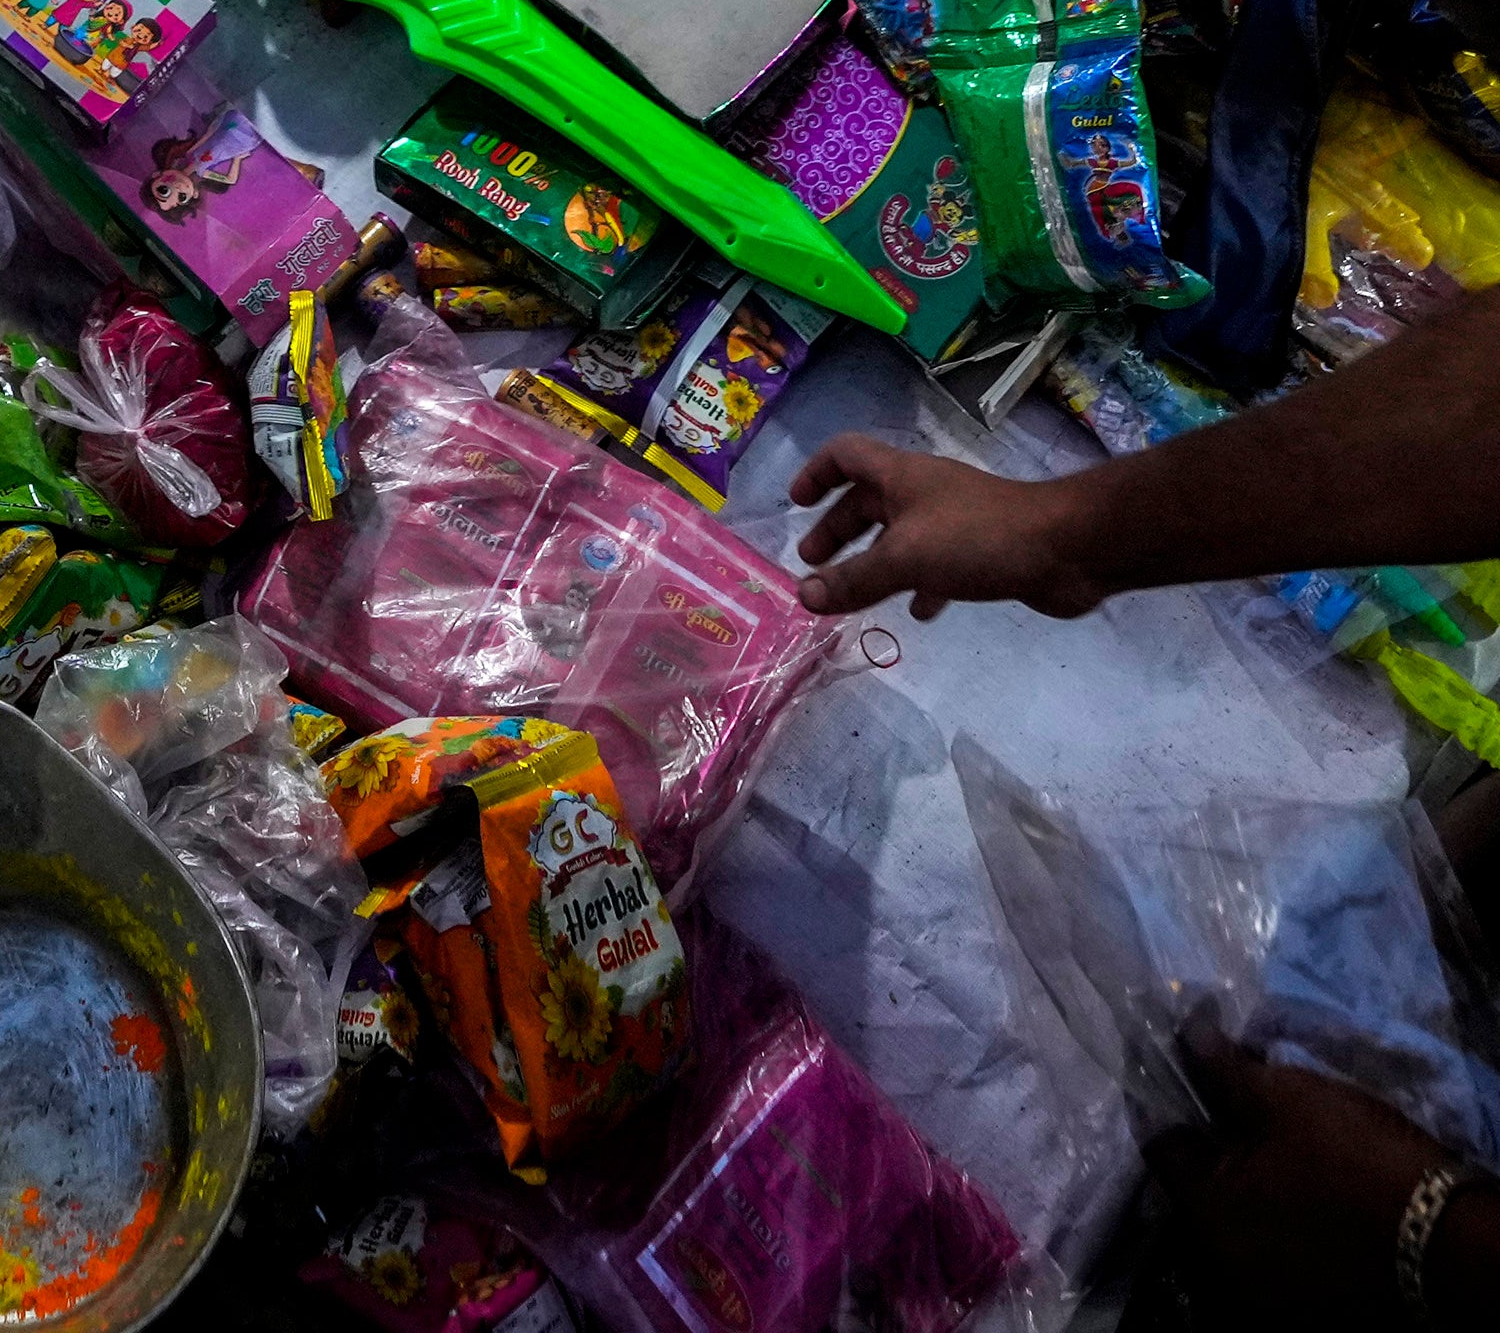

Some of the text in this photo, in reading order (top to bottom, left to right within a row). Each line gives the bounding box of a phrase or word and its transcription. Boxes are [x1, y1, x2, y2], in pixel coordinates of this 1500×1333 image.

[1071, 115, 1113, 128] Gulal
[433, 149, 531, 222] Rooh Rang
[563, 866, 650, 947] Herbal
[596, 918, 660, 973] Gulal
